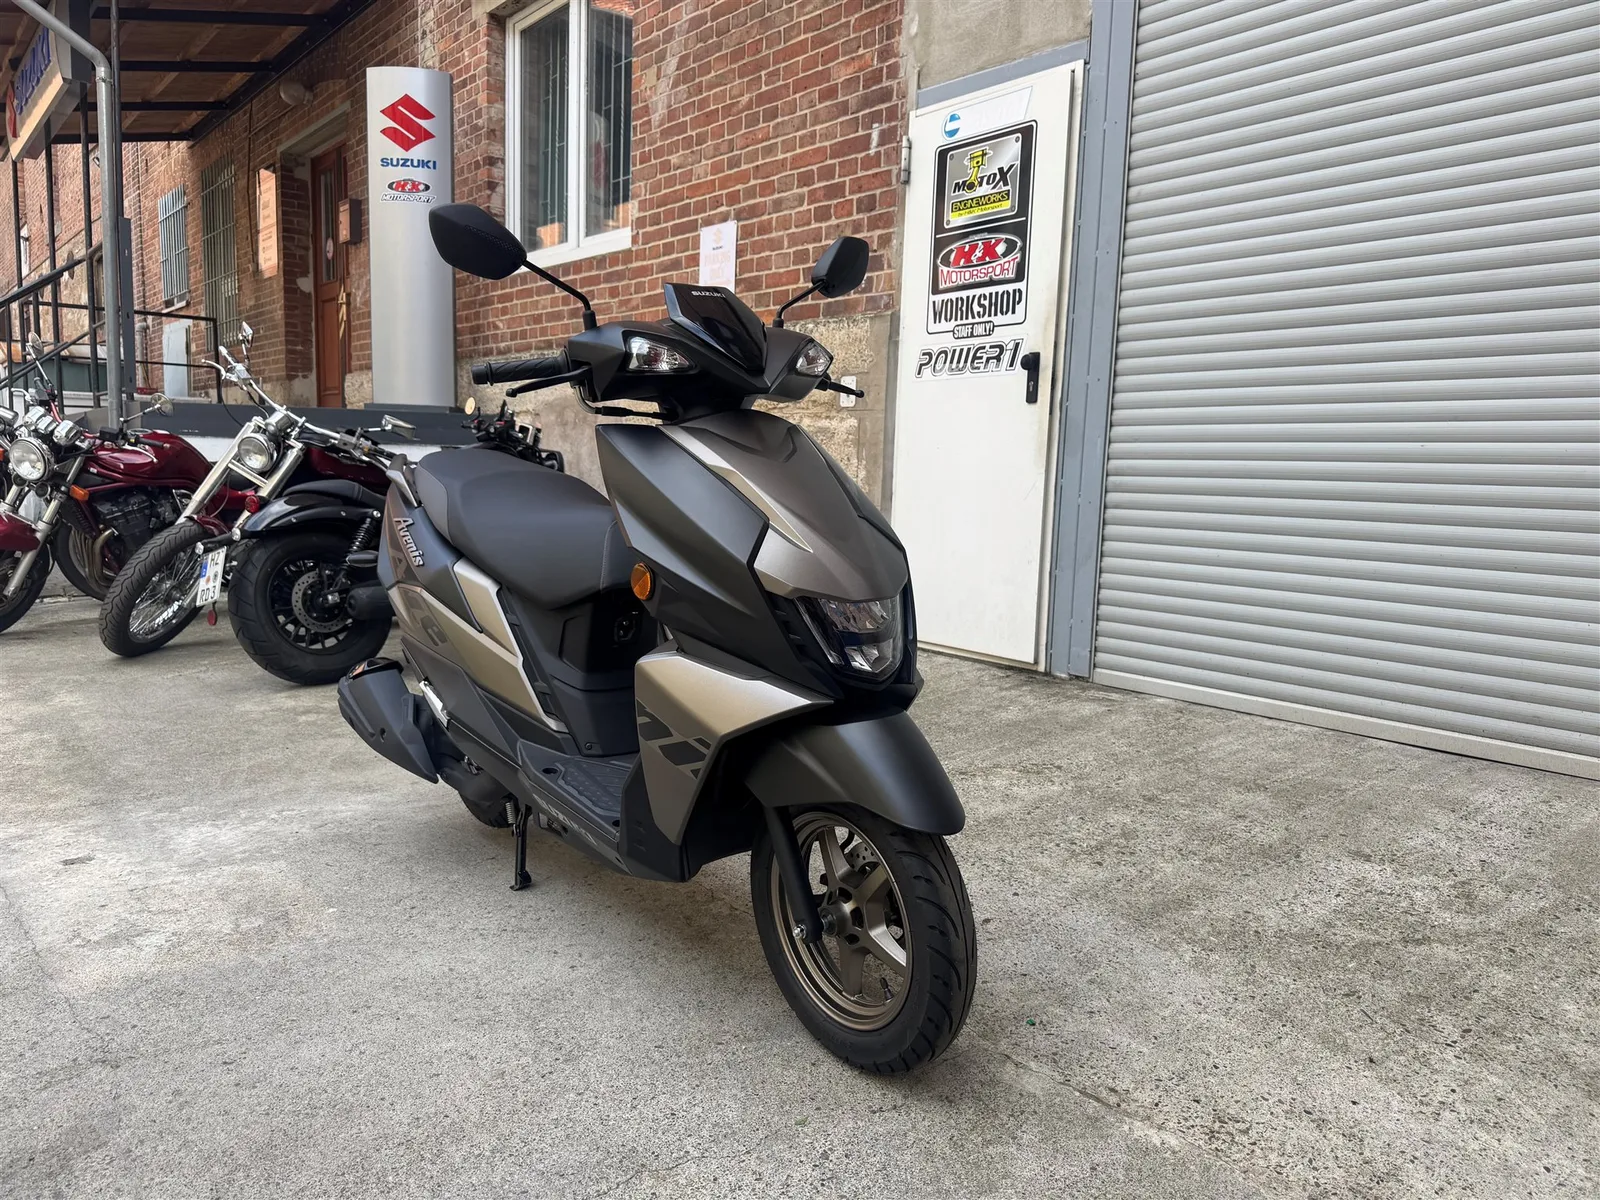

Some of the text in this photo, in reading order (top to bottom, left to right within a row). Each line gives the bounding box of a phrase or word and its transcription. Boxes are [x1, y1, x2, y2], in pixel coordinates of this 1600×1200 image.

[15, 26, 51, 116] SUZUKI
[380, 157, 437, 170] SUZUKI
[381, 193, 436, 204] MOTORSPORT
[952, 191, 1008, 212] ENGINEWORKS
[950, 238, 1006, 267] H&K
[940, 255, 1019, 287] MOTORSPORT
[691, 290, 726, 298] SUZUKI
[932, 288, 1023, 324] WORKSHOP
[954, 322, 993, 338] STAFF ONLY!
[394, 517, 425, 567] Avenis
[210, 551, 221, 568] HZ
[200, 585, 217, 603] RD 3
